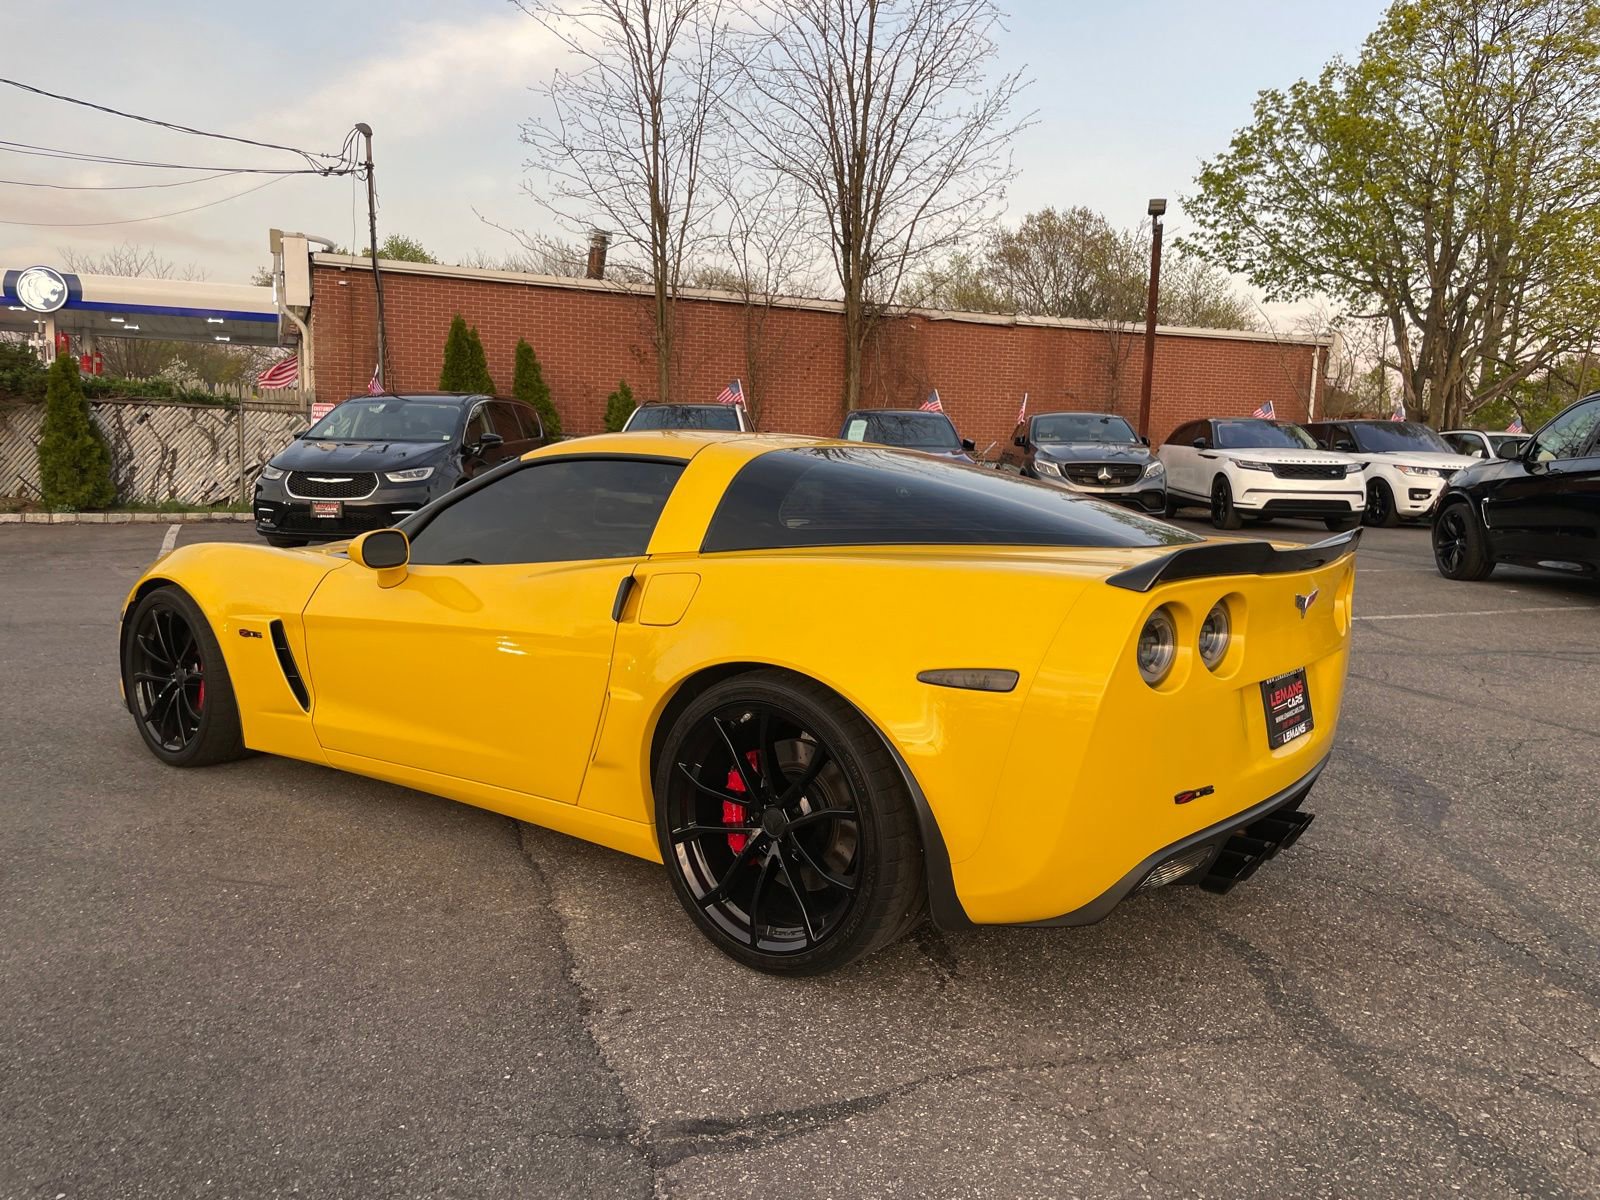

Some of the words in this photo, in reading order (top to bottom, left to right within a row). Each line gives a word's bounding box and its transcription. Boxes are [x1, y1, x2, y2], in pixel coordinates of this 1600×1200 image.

[1270, 680, 1304, 707] LEMANS
[1287, 694, 1303, 708] CARS
[1282, 723, 1306, 743] LEMANS
